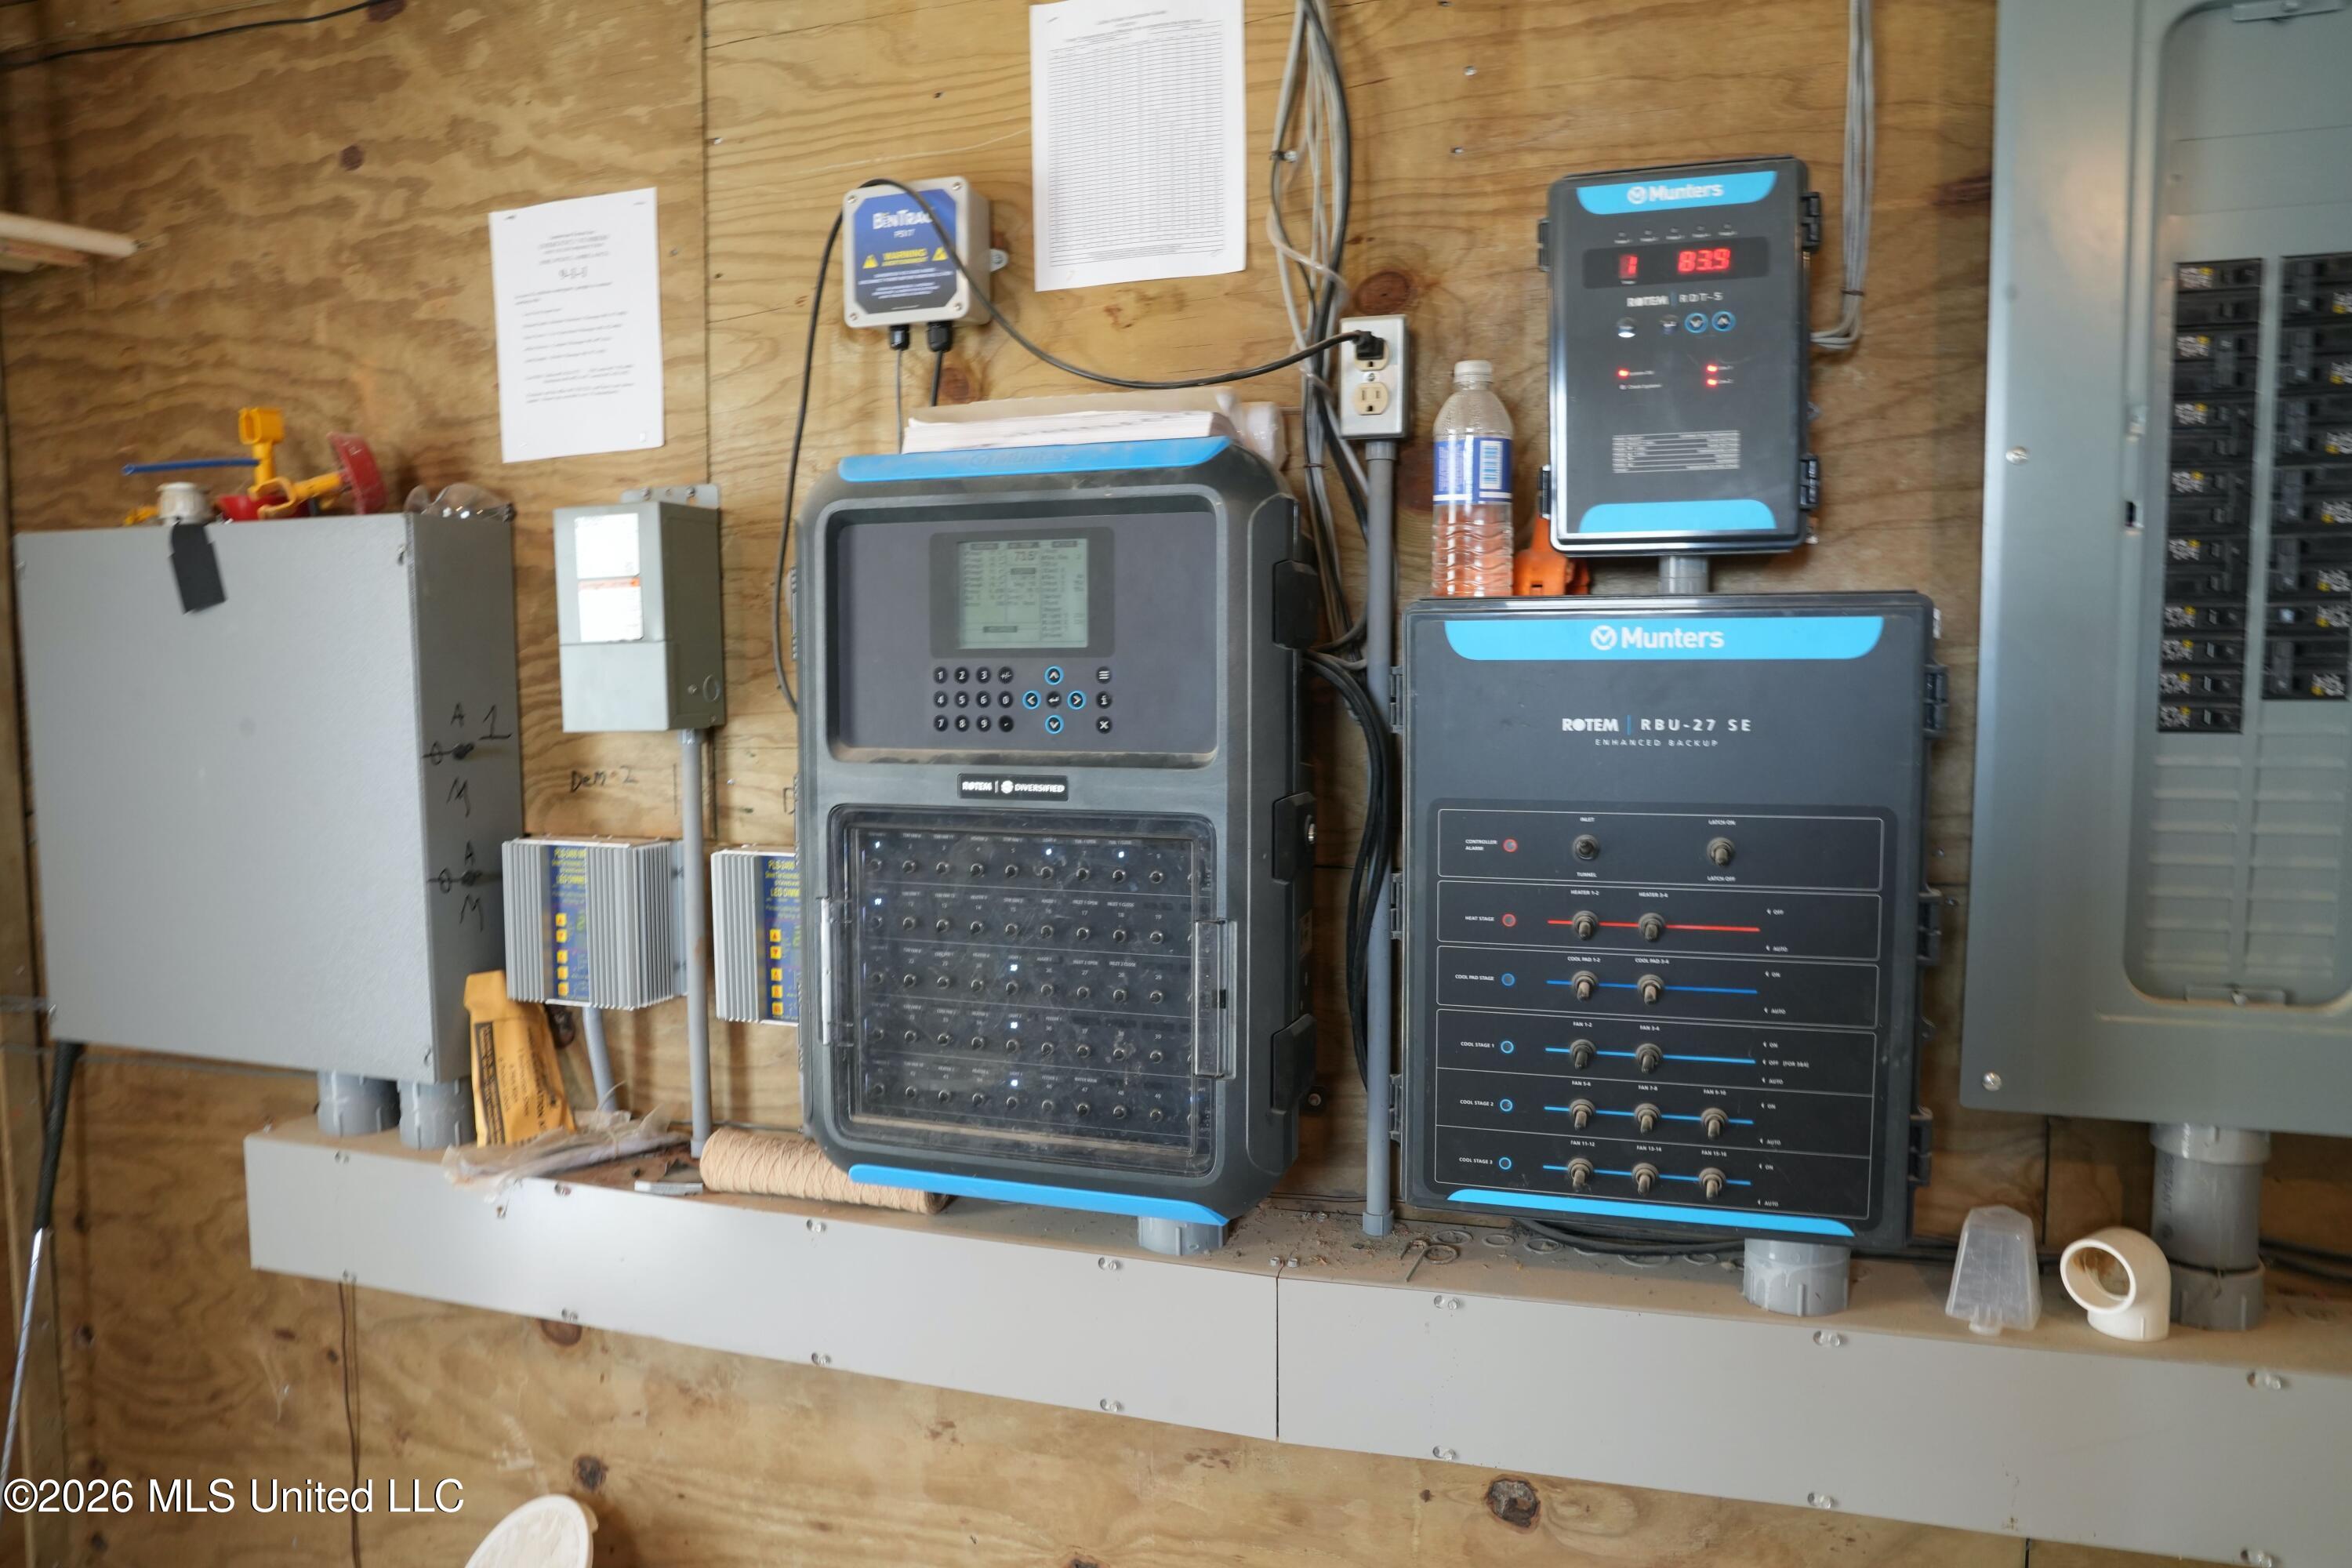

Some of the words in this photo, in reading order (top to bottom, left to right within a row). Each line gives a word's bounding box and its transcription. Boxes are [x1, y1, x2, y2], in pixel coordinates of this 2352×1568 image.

[1649, 184, 1724, 201] Munters
[1627, 295, 1670, 307] ROTEM
[1621, 626, 1726, 649] Munters
[938, 670, 944, 680] 1
[958, 670, 966, 680] 2
[980, 670, 988, 680] 3
[937, 695, 944, 704] 4
[958, 695, 966, 704] 5
[980, 695, 987, 704] 6
[1002, 695, 1010, 704] 0
[938, 719, 945, 728] 7
[959, 719, 966, 728] 8
[981, 719, 988, 728] 9
[1562, 717, 1620, 732] ROTEM
[1640, 718, 1717, 731] RBU-27
[1727, 719, 1751, 731] SE
[1668, 739, 1719, 747] BACKUP
[962, 781, 993, 791] ROTEM
[1014, 783, 1065, 793] DIVERSIFIED
